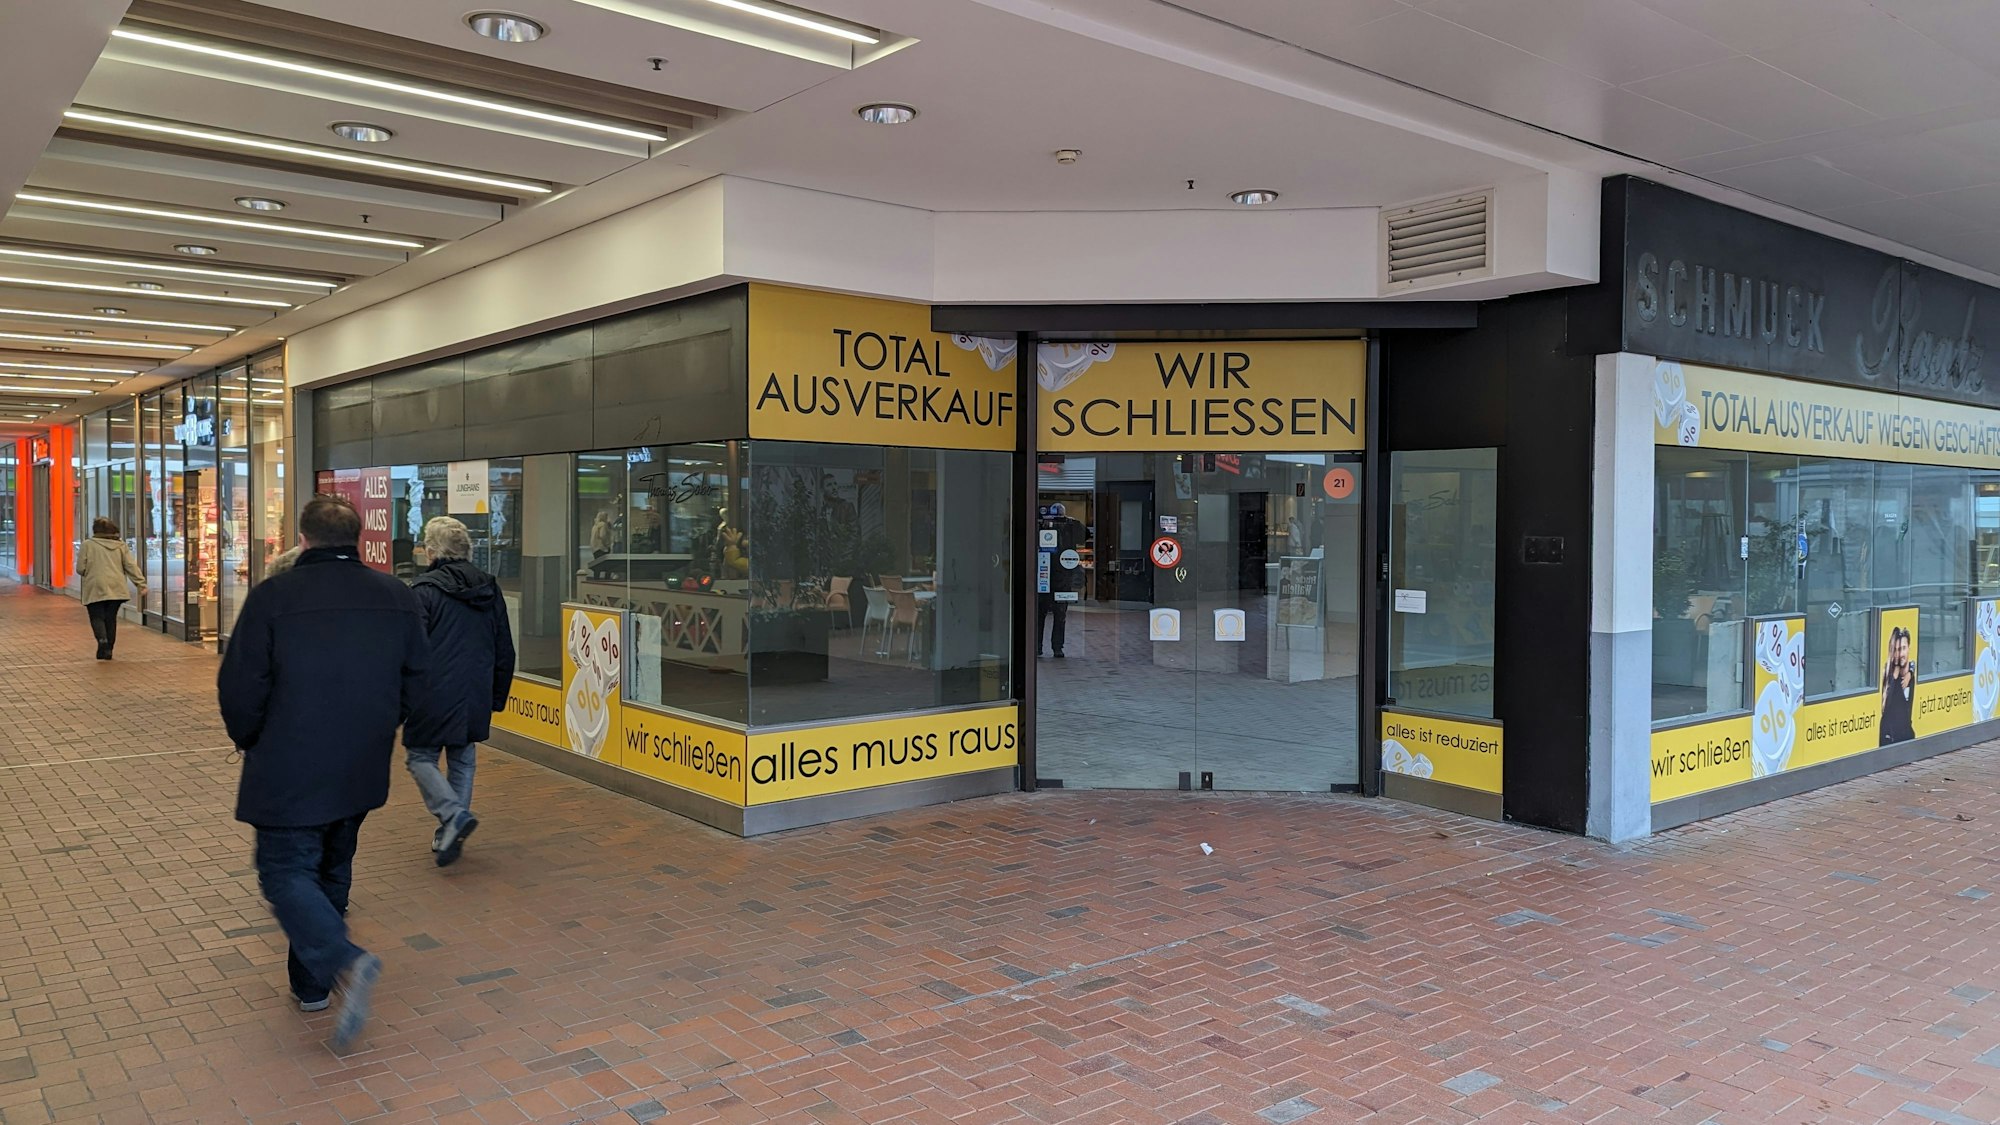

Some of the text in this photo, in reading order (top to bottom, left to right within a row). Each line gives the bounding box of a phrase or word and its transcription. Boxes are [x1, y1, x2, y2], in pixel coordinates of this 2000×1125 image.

[1637, 252, 1825, 354] SCHMUCK
[833, 328, 950, 377] TOTAL
[1154, 352, 1250, 389] WIR
[756, 372, 1013, 427] AUSVERKAUF
[1050, 398, 1356, 437] SCHLIESSEN
[1701, 390, 1762, 434] TOTAL
[1764, 398, 1874, 444] AUSVERKAUF
[1877, 411, 1930, 450] WEGEN
[364, 475, 388, 499] ALLES
[1333, 478, 1345, 488] 21
[365, 508, 387, 531] MUSS
[365, 541, 387, 564] RAUS
[508, 696, 560, 726] muss raus
[1918, 687, 1972, 719] jetzt zugreifen
[1386, 724, 1499, 755] alles ist reduziert
[1806, 710, 1875, 742] alles ist reduziert
[626, 723, 741, 783] wir schließen
[751, 723, 1016, 785] alles muss raus
[1651, 737, 1750, 779] wir schließen
